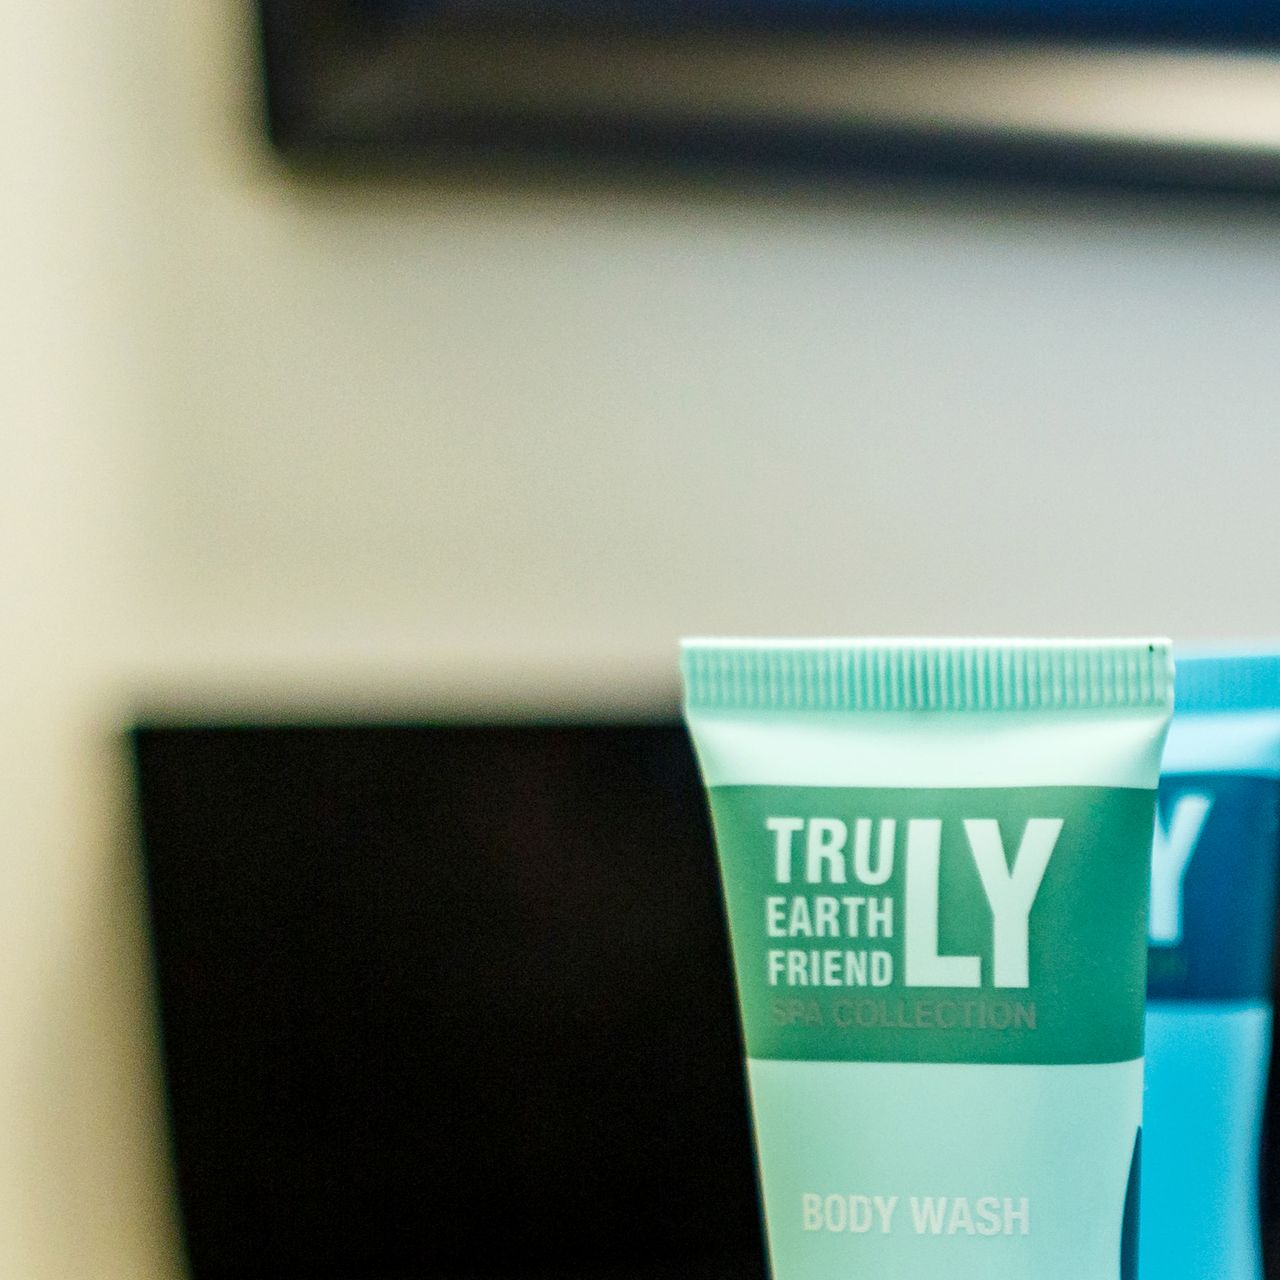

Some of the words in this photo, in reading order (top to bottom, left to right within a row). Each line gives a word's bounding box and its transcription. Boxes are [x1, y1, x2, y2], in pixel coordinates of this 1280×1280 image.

[765, 817, 896, 886] TRU
[765, 895, 894, 938] EARTH
[767, 950, 894, 988] FRIEND
[771, 1000, 823, 1027] SPA
[836, 1000, 1037, 1031] COLLECTION
[801, 1193, 900, 1235] BODY
[910, 1196, 1031, 1236] WASH
